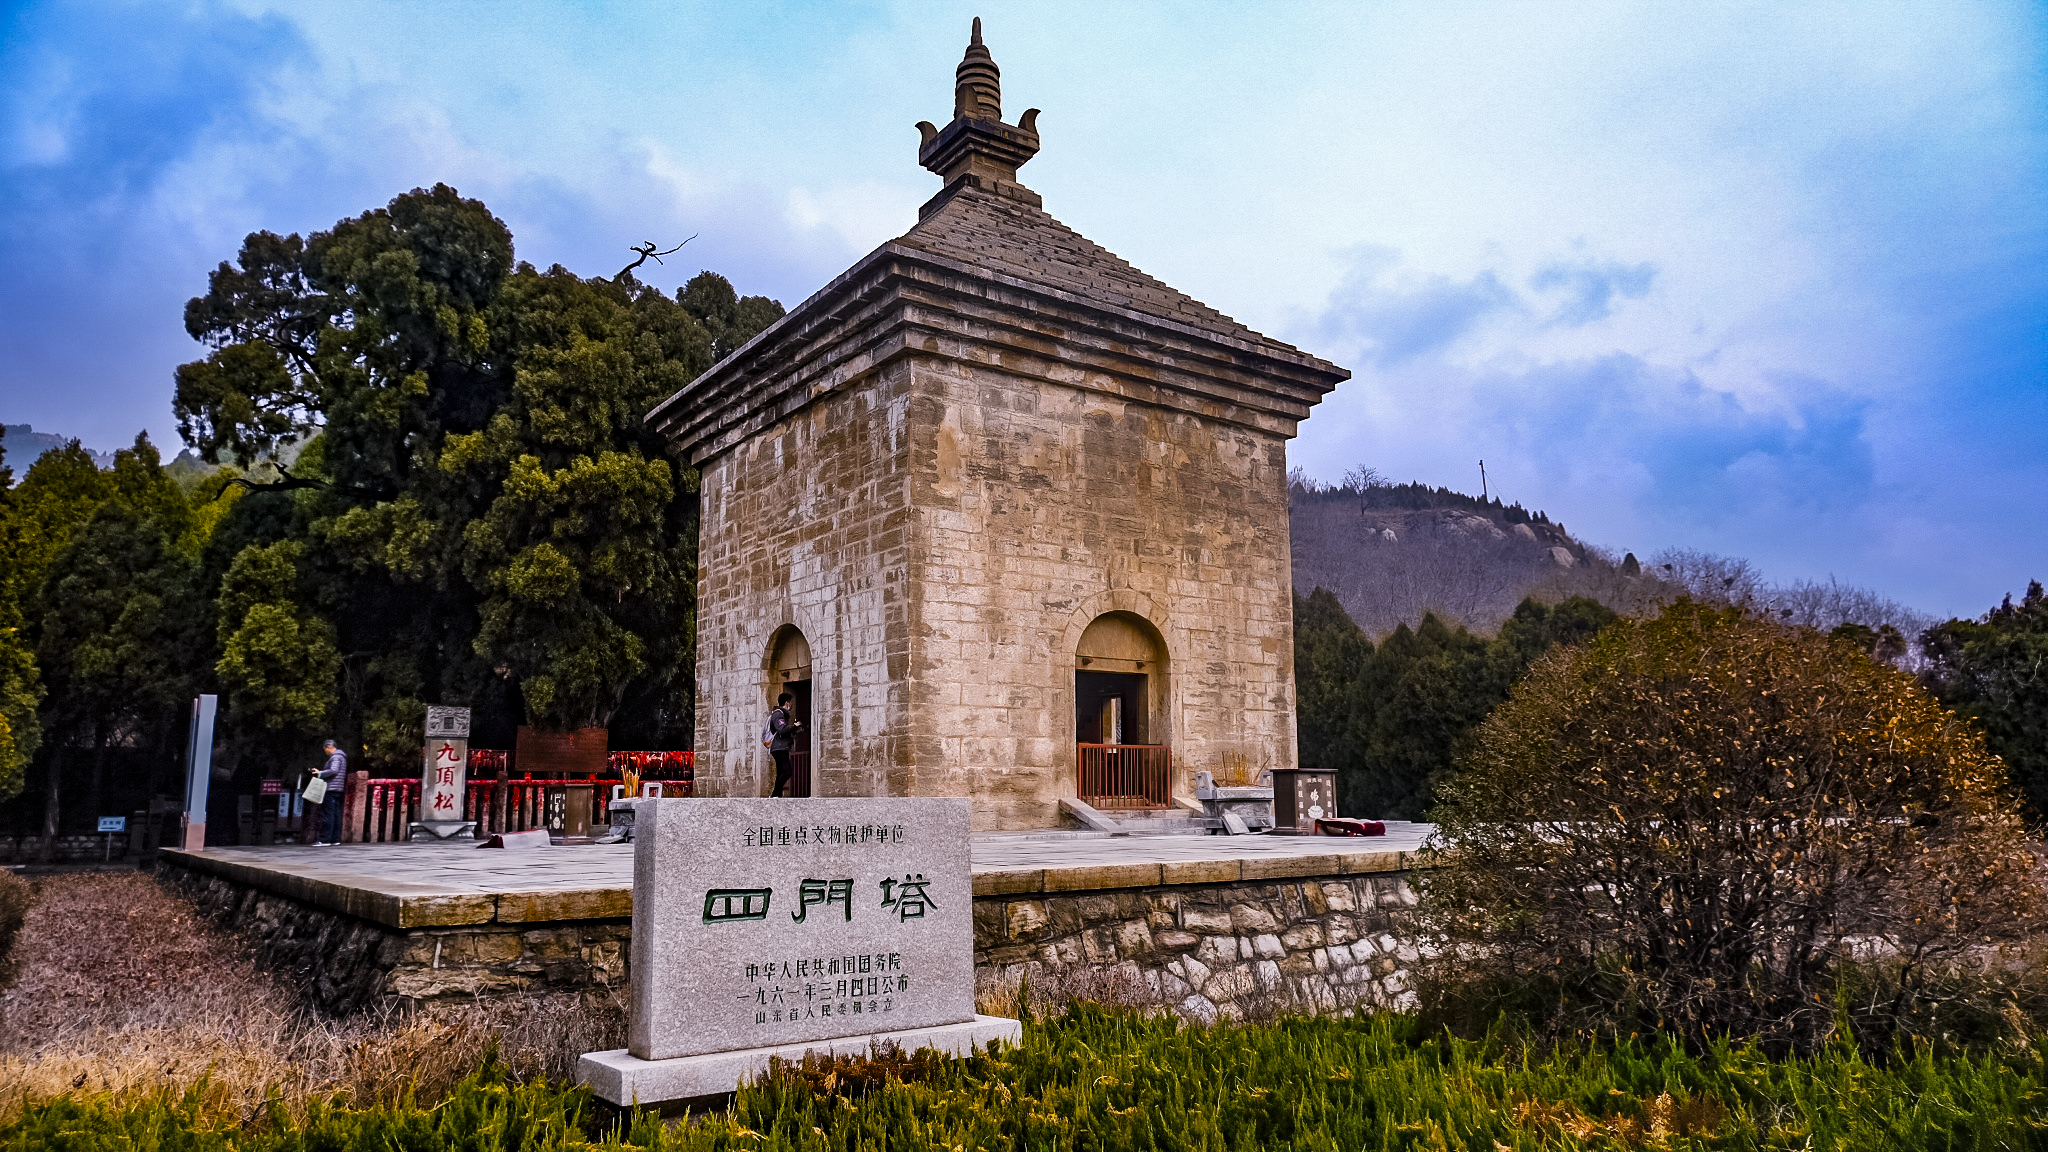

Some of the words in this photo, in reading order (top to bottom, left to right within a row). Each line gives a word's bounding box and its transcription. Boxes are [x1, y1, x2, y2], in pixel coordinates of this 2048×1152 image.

[433, 743, 461, 811] 九頂松
[742, 824, 904, 847] 全国重点文物保护单位
[702, 873, 938, 925] 四門塔
[745, 952, 901, 983] 中华人民共和国国务院
[736, 973, 909, 1005] 一九六一年三月四日公布
[755, 998, 893, 1025] 山东省人民委员会立
